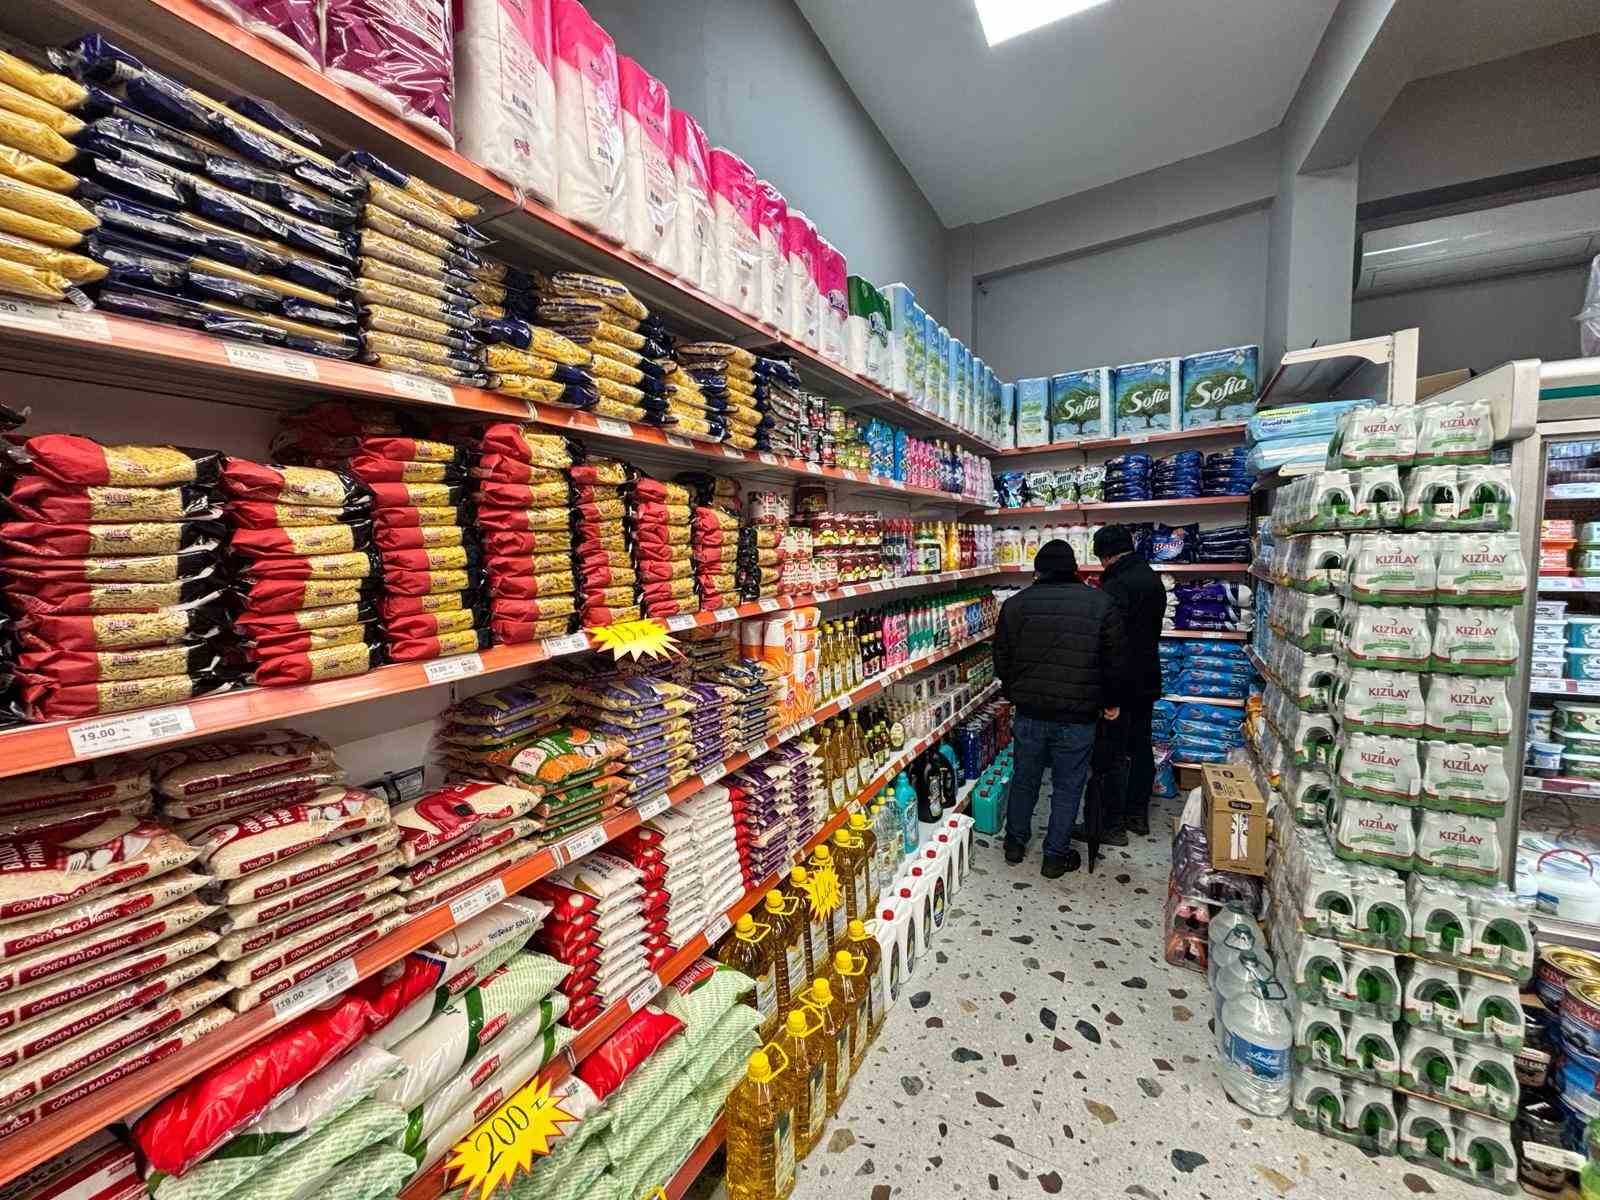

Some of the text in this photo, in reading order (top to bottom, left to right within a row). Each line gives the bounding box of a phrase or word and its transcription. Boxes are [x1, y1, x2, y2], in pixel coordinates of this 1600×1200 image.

[1191, 377, 1247, 408] Sofia
[1061, 394, 1100, 420] Sofia
[1126, 388, 1170, 413] Sofia
[1376, 554, 1420, 565] KIZILAY
[1462, 554, 1507, 564] KIZILAY
[1372, 624, 1414, 636] KIZILAY
[1456, 625, 1498, 636] KIZILAY
[1368, 687, 1411, 699] KIZILAY
[1450, 693, 1495, 705] KIZILAY
[80, 728, 116, 742] 19.00
[1361, 752, 1400, 766] KIZILAY
[1442, 759, 1489, 773] KIZILAY
[1358, 818, 1398, 832] KIZILAY
[1439, 830, 1483, 845] KIZILAY
[69, 947, 101, 964] BALDO
[70, 981, 102, 998] BALDO
[72, 1013, 105, 1032] BALDO
[89, 1041, 120, 1059] BALDO
[89, 1072, 120, 1089] BALDO
[475, 1105, 530, 1173] 200
